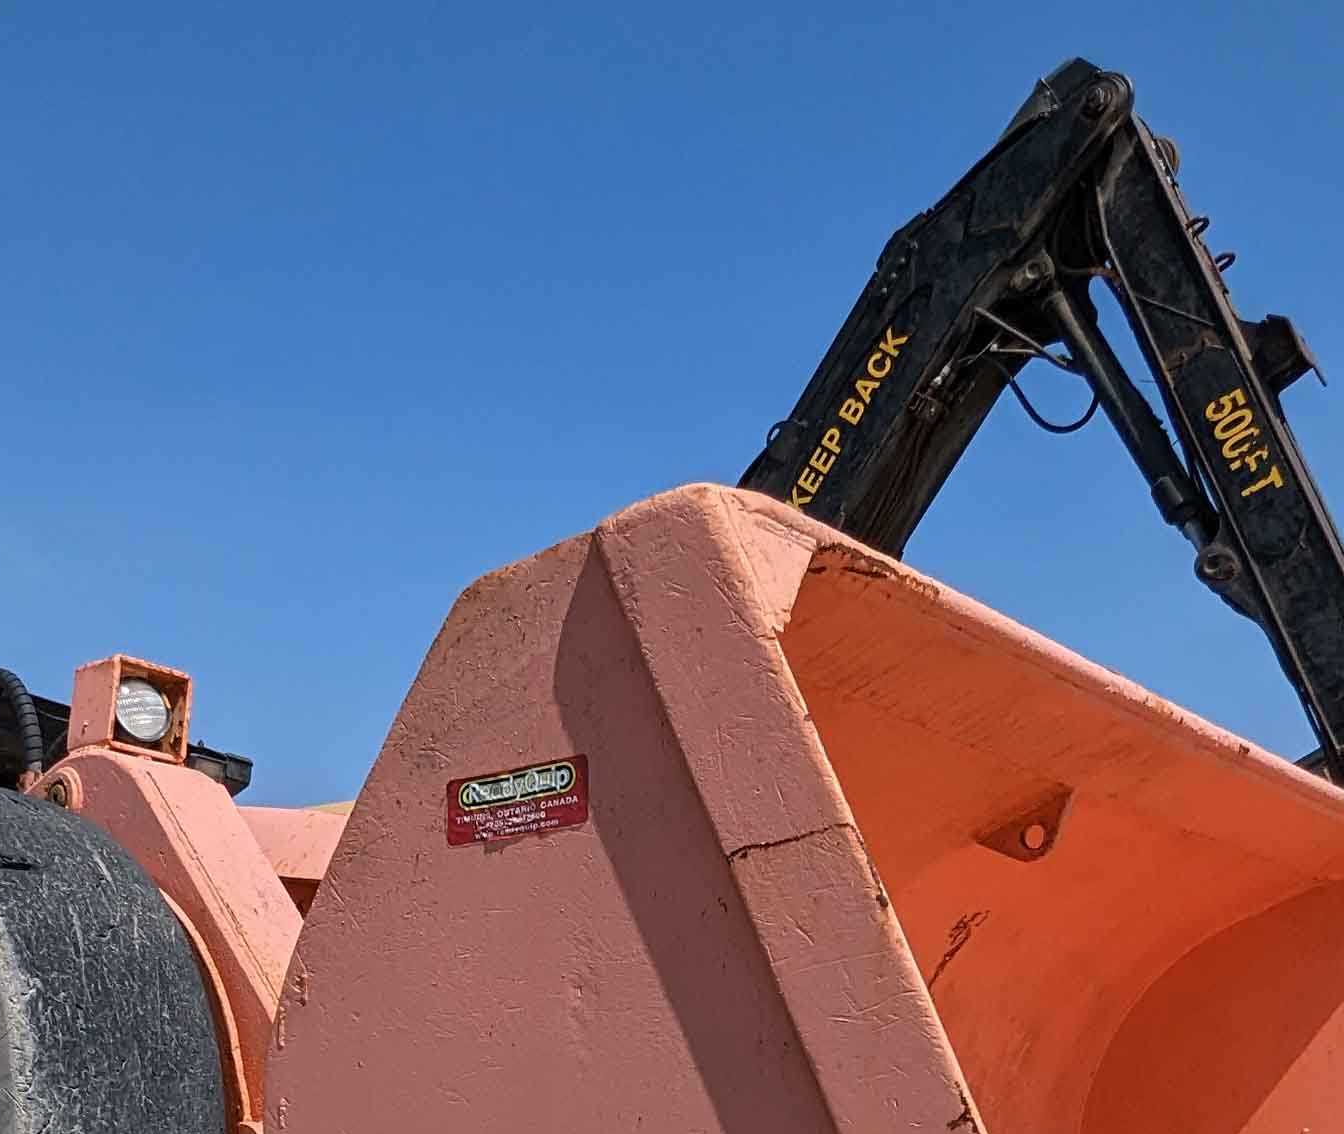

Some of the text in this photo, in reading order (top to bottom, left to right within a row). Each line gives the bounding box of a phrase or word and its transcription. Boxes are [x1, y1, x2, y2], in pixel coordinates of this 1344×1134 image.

[788, 325, 909, 509] KEEP BACK
[540, 795, 578, 810] CANADA
